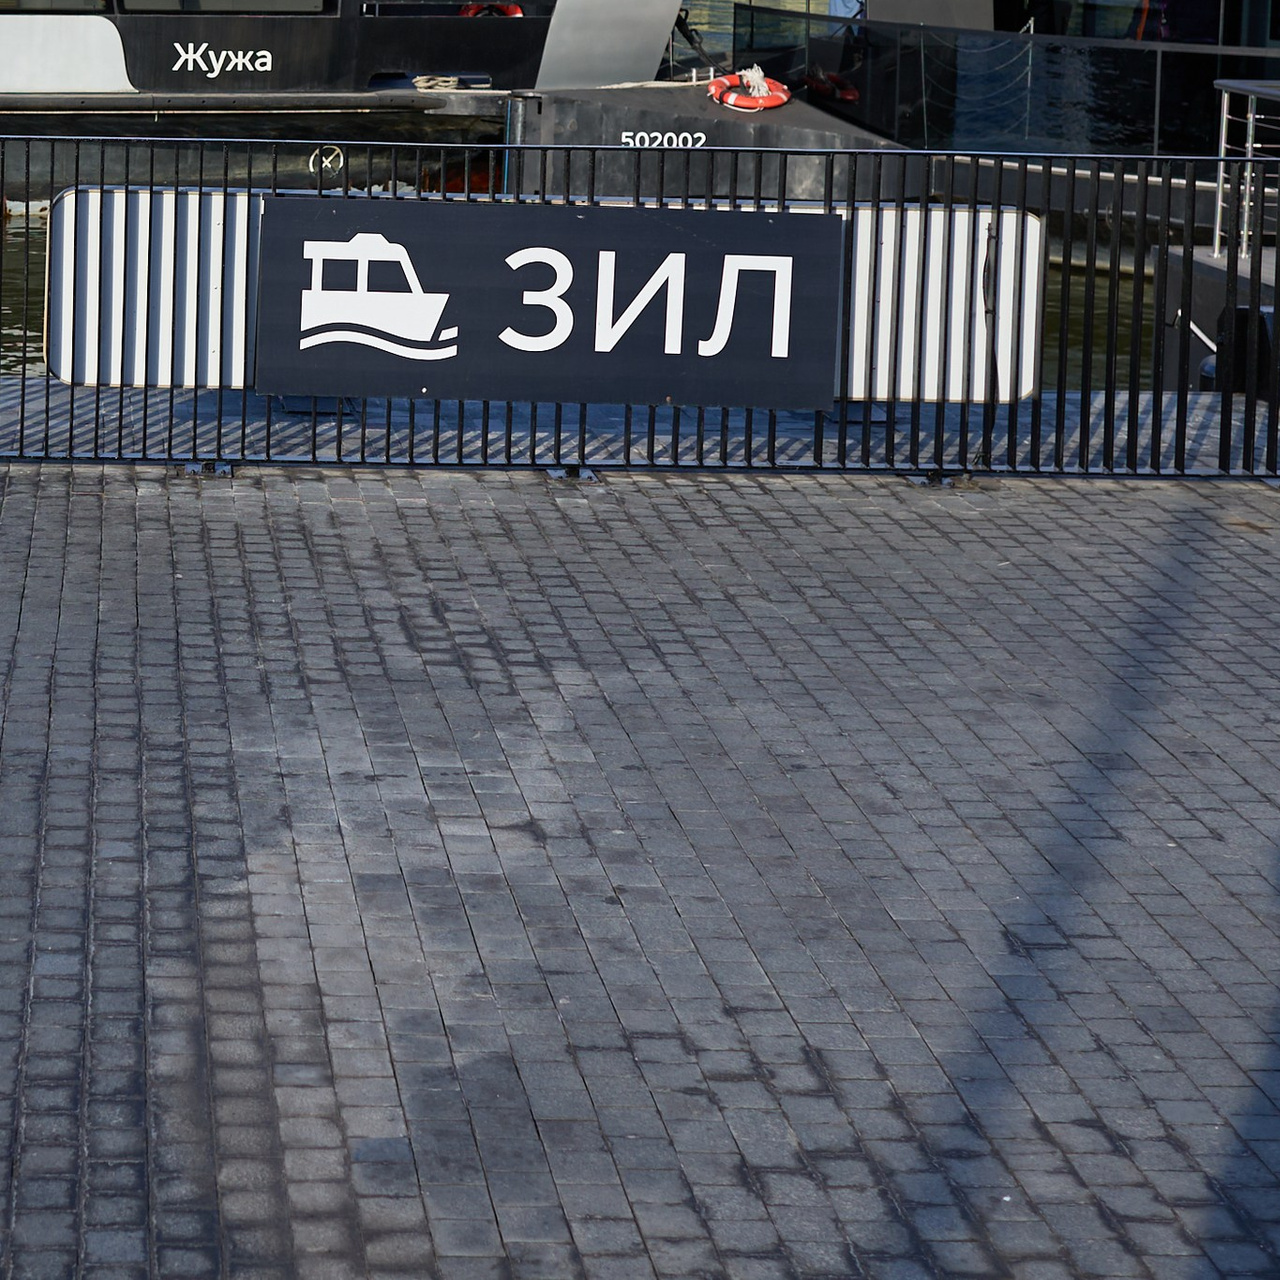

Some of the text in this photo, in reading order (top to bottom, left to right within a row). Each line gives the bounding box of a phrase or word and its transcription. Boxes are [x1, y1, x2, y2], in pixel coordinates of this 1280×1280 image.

[172, 42, 273, 78] Жужа
[621, 131, 707, 148] 502002
[498, 247, 793, 358] ЗИЛ
